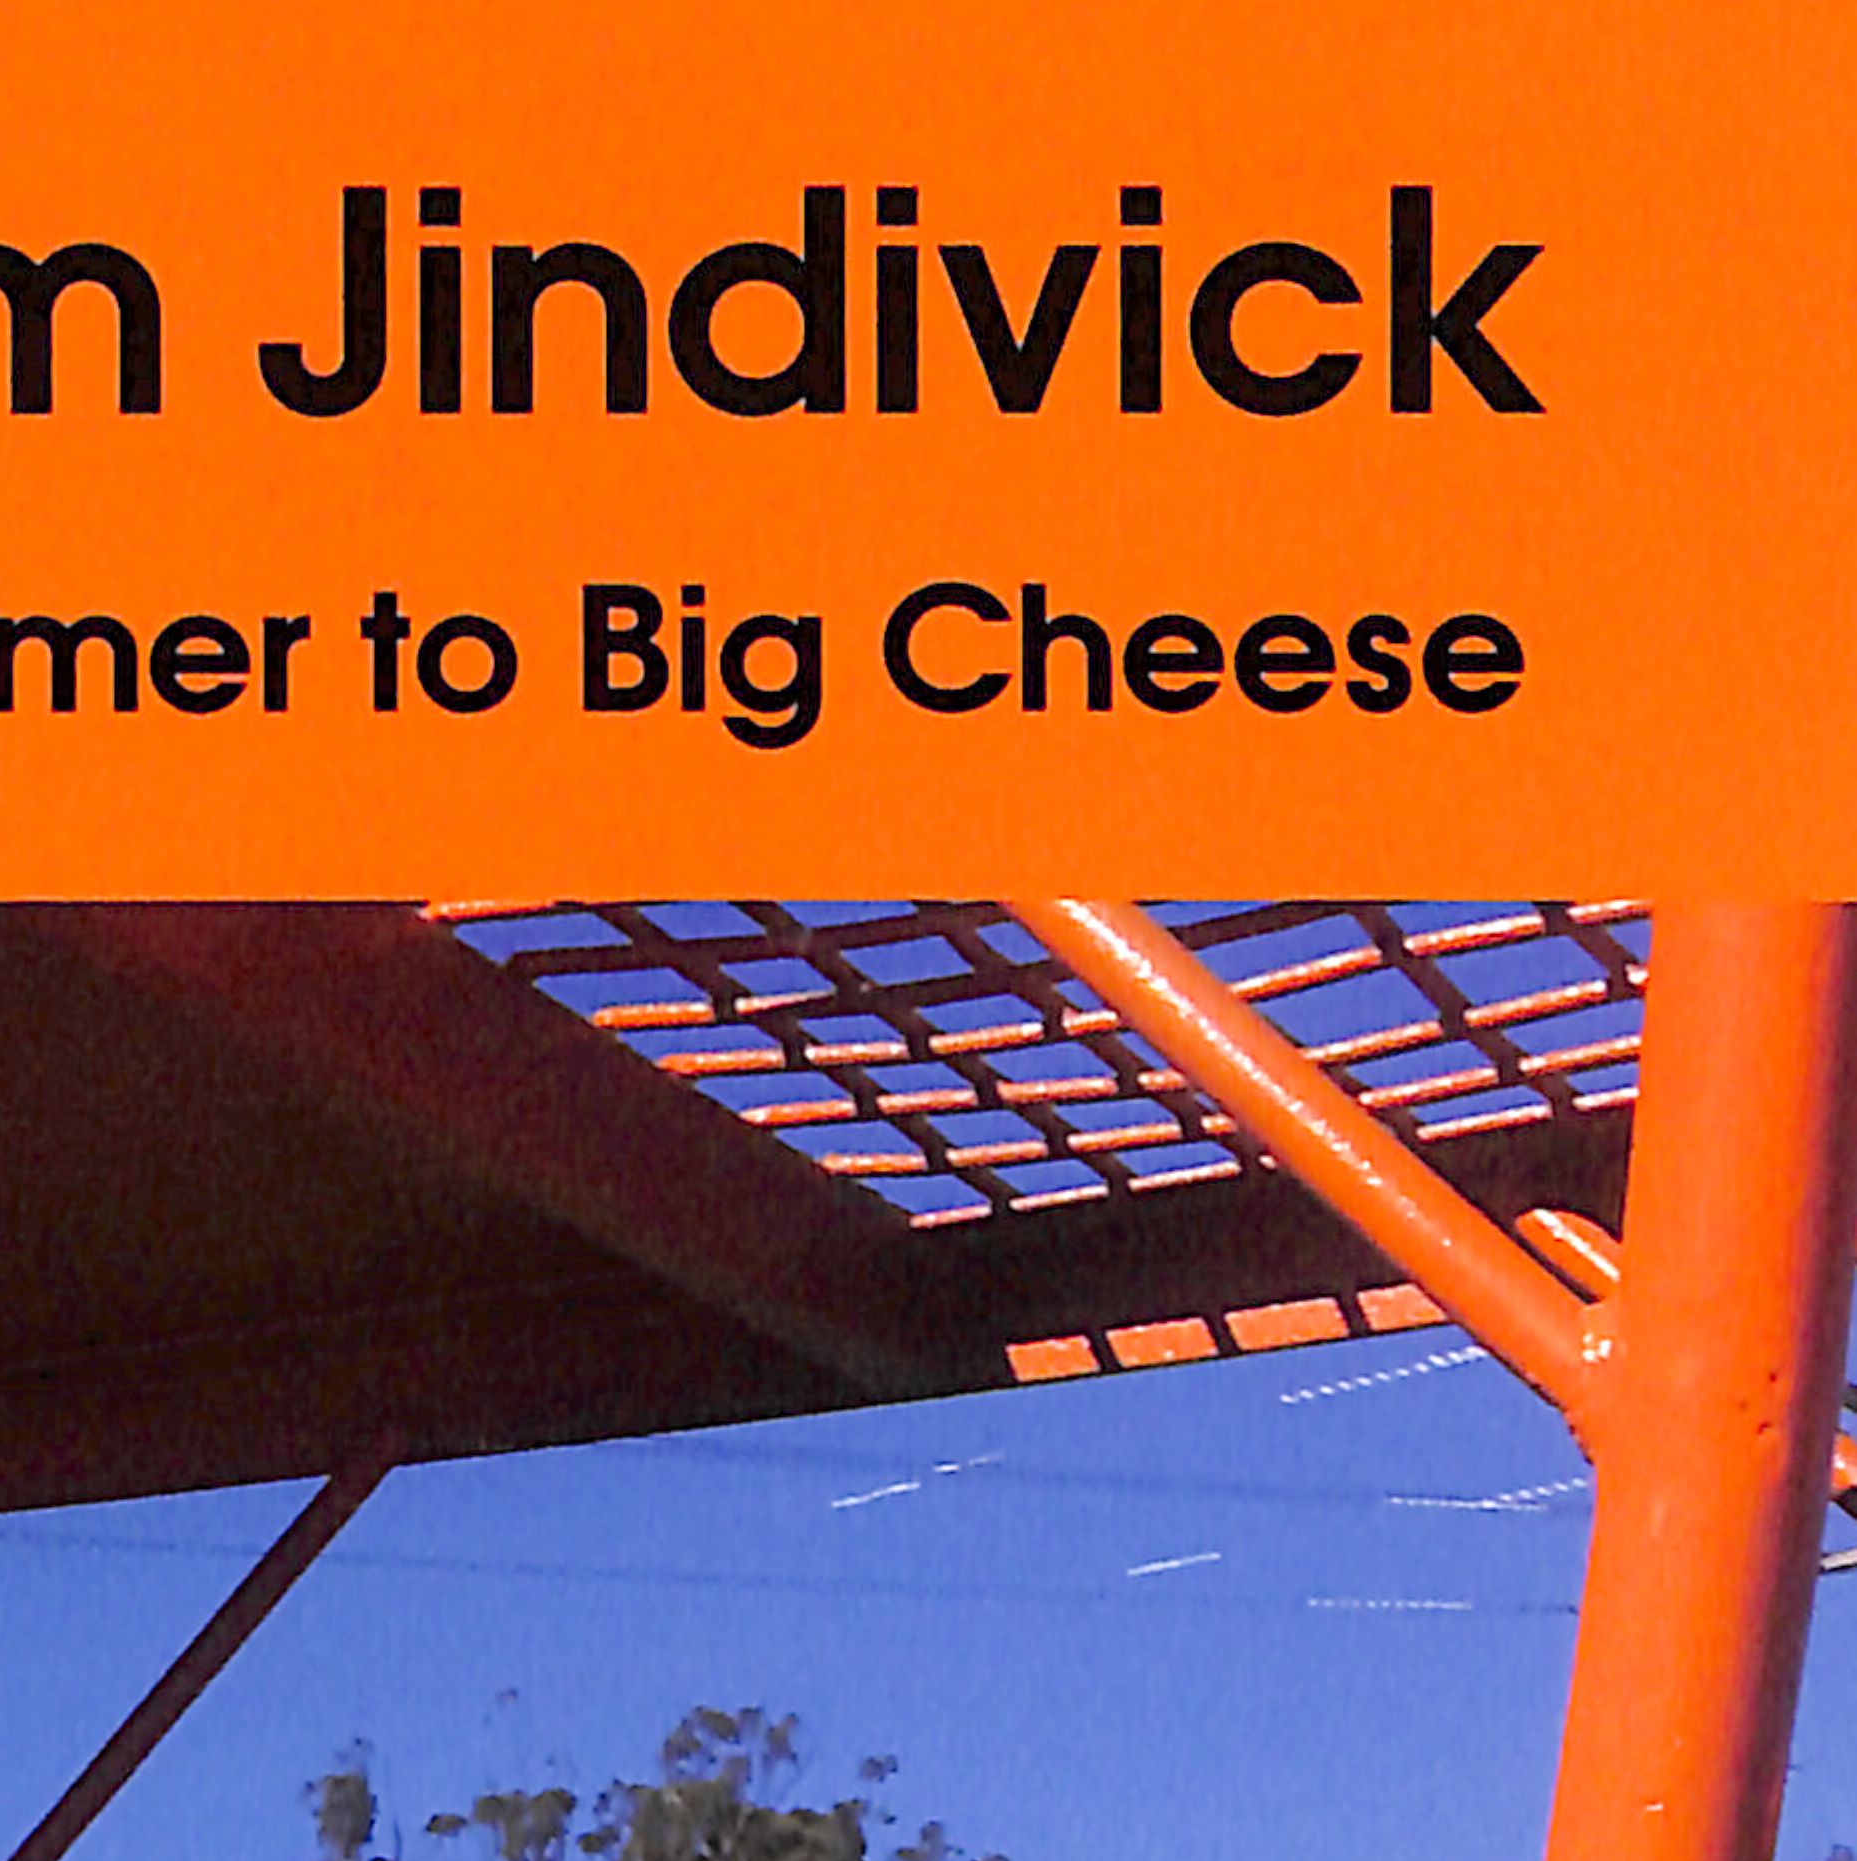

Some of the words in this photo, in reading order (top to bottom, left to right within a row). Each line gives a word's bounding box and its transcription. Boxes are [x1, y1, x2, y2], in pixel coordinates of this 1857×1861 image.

[257, 185, 1545, 419] Jindivick
[359, 590, 519, 715] to
[581, 582, 823, 751] Big
[882, 581, 1525, 714] Cheese
